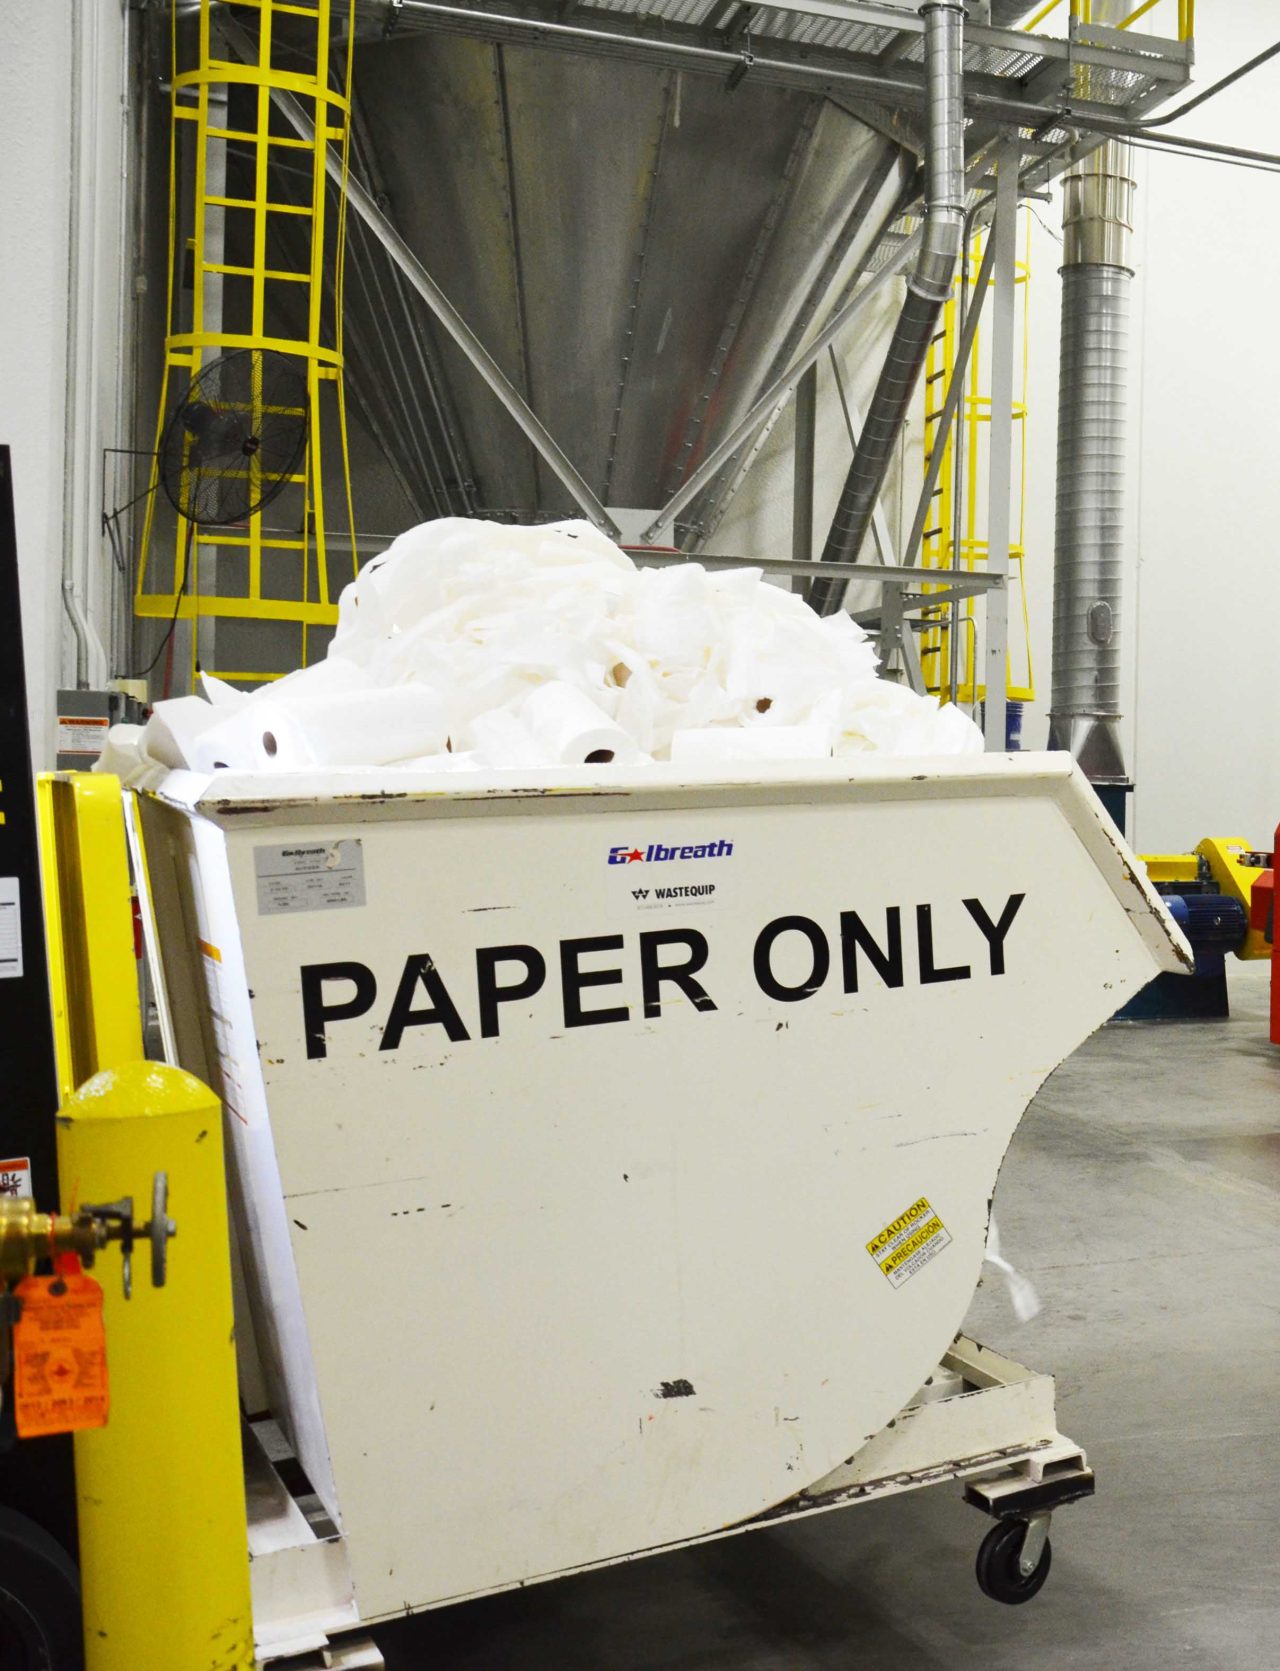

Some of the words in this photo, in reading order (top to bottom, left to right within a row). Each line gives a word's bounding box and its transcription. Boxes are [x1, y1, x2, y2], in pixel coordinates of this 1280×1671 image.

[655, 884, 716, 899] WASTEQUIP
[299, 927, 719, 1060] PAPER
[752, 892, 1027, 1003] ONLY
[878, 1199, 927, 1245] CAUTION
